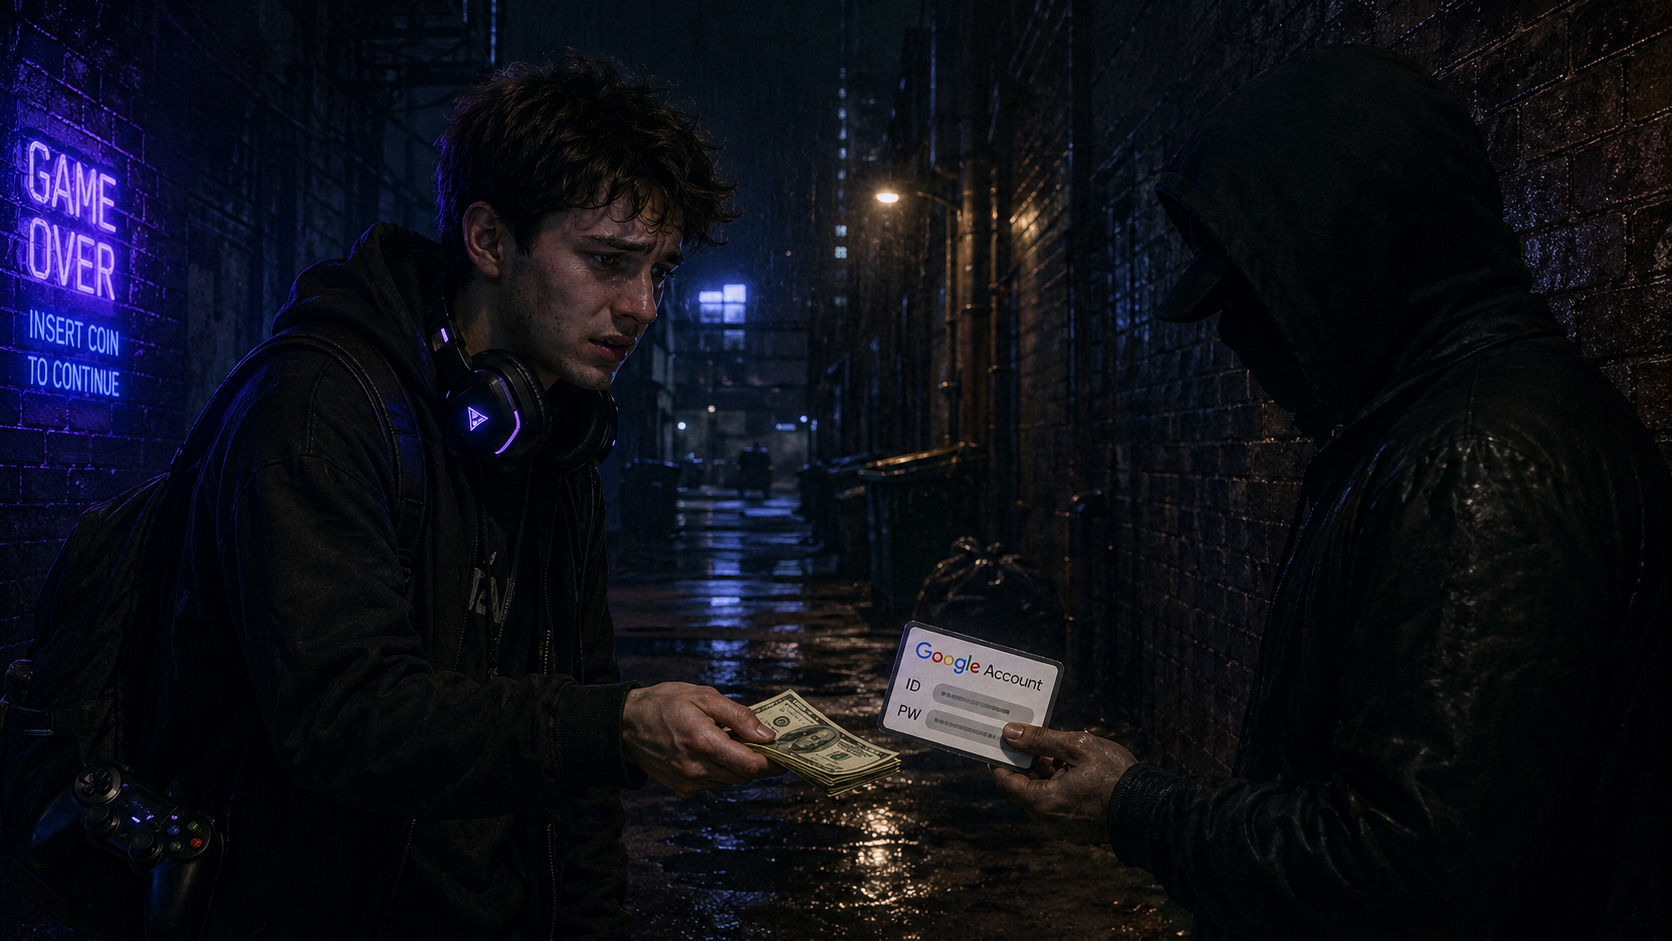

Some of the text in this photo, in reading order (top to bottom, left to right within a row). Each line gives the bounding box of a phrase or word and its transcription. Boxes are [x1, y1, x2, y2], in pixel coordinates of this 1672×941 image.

[28, 140, 117, 233] GAME
[28, 217, 115, 301] OVER
[29, 309, 119, 357] INSERT COIN
[27, 355, 120, 398] TO CONTINUE
[905, 677, 921, 693] ID
[915, 641, 1043, 692] Google Account
[897, 704, 922, 721] PW
